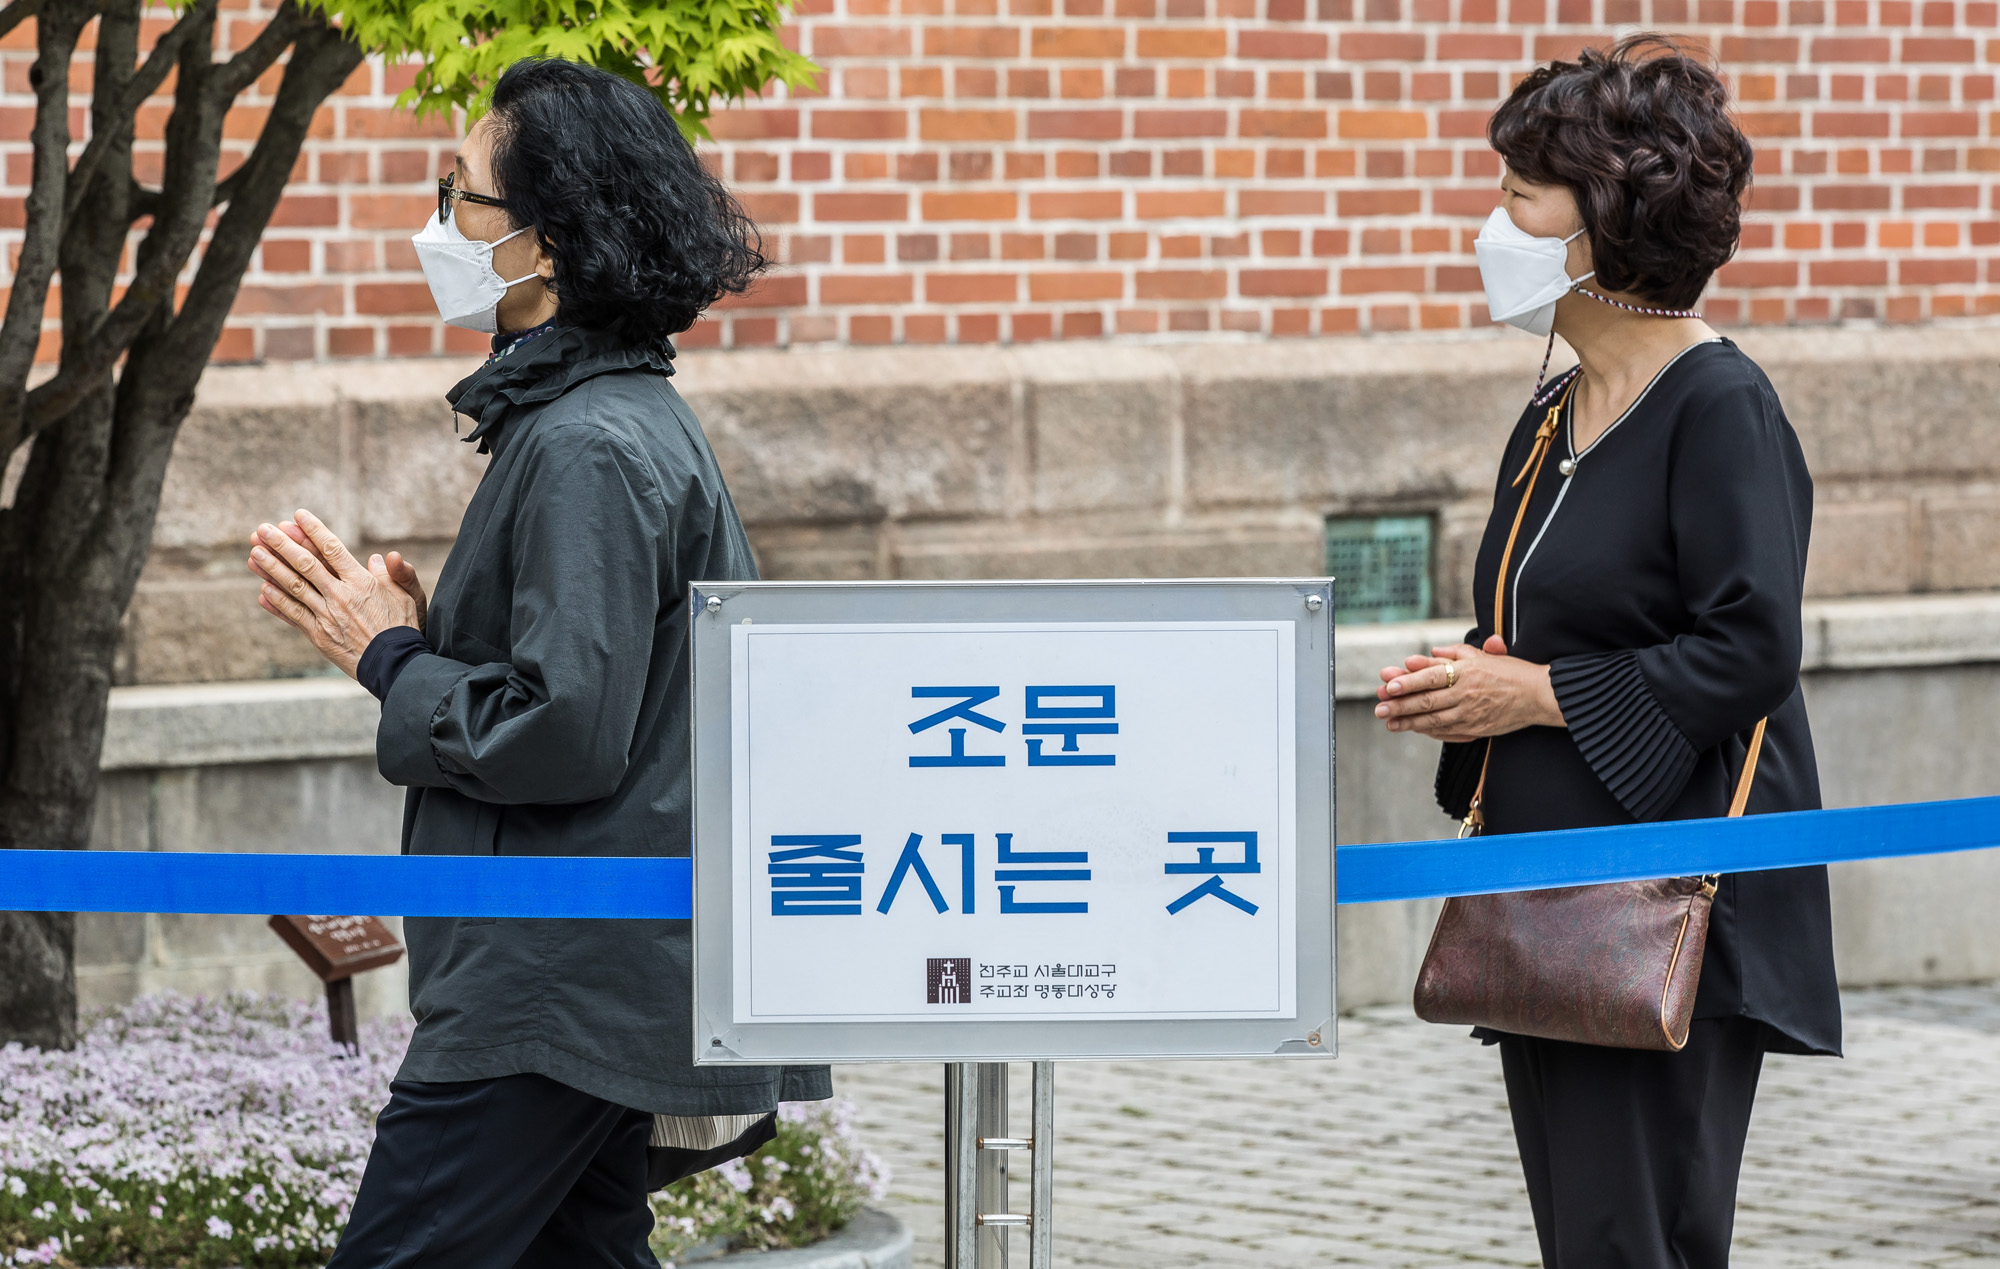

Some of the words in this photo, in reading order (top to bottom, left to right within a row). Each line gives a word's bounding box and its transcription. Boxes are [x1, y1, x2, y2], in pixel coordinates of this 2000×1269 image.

[908, 685, 1119, 768] 조문
[768, 832, 1091, 916] 줄서는
[1165, 831, 1261, 916] 곳
[979, 963, 1028, 978] 천주교
[1034, 963, 1117, 978] 서울대교구
[979, 985, 1029, 998] 주교좌
[1034, 984, 1117, 999] 명동대성당
